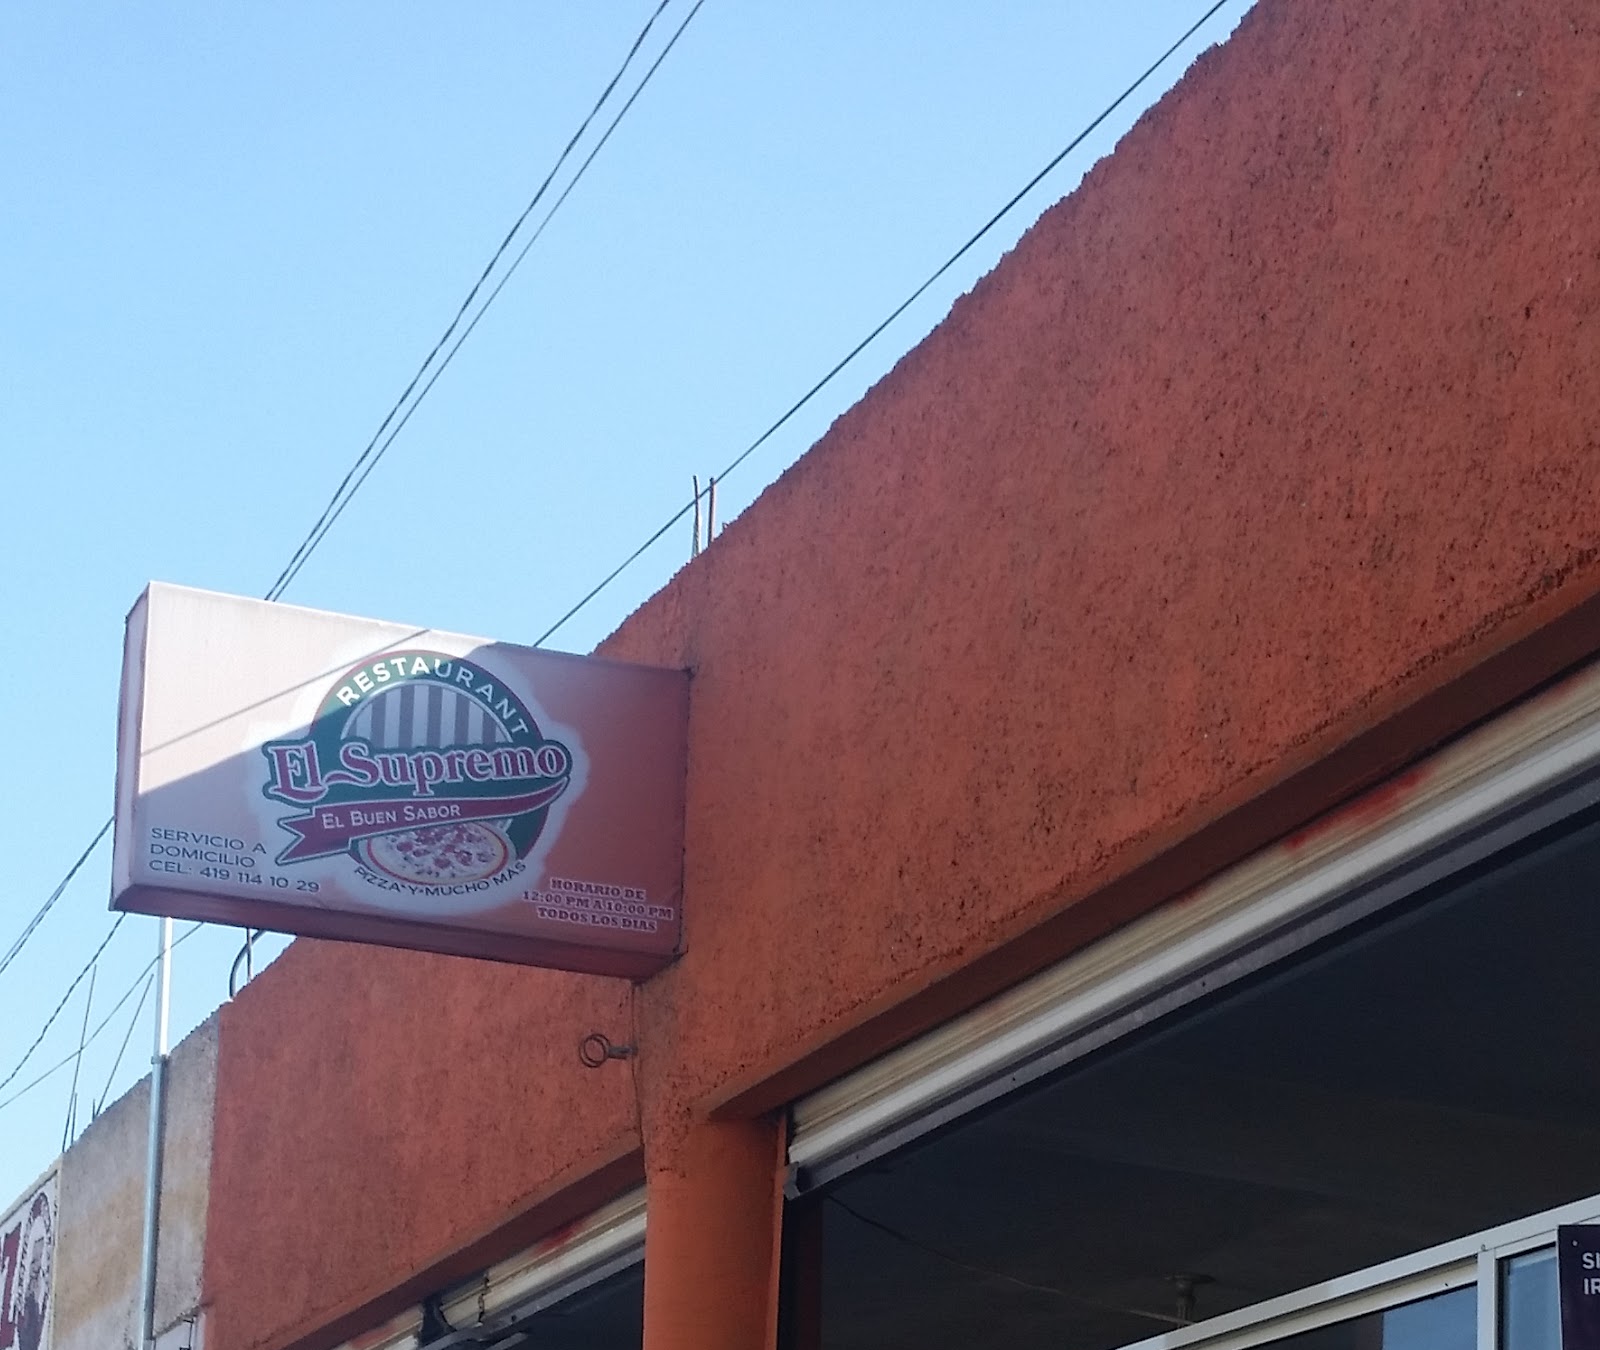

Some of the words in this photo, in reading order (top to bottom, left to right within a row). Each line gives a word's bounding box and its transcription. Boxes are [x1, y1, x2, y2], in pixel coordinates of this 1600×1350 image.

[336, 656, 529, 735] RESTAURANT
[268, 740, 328, 801] El
[323, 742, 567, 796] Supremo
[151, 828, 244, 850] SERVICIO
[252, 843, 267, 854] A
[150, 844, 255, 868] DOMICILIO
[149, 860, 192, 875] CEL:
[200, 867, 230, 880] 419
[238, 872, 262, 885] 114
[270, 876, 289, 888] 10
[296, 880, 320, 893] 29
[354, 866, 400, 892] PIZZA
[425, 880, 490, 896] MUCHO
[551, 878, 621, 896] HORARIO
[624, 888, 646, 900] DE
[523, 890, 562, 904] 12:00
[565, 895, 590, 908] PM
[593, 899, 603, 910] A
[607, 902, 645, 915] 10:00
[648, 907, 673, 919] PM
[538, 907, 588, 923] TODOS
[591, 914, 618, 927] LOS
[622, 918, 657, 931] DIAS
